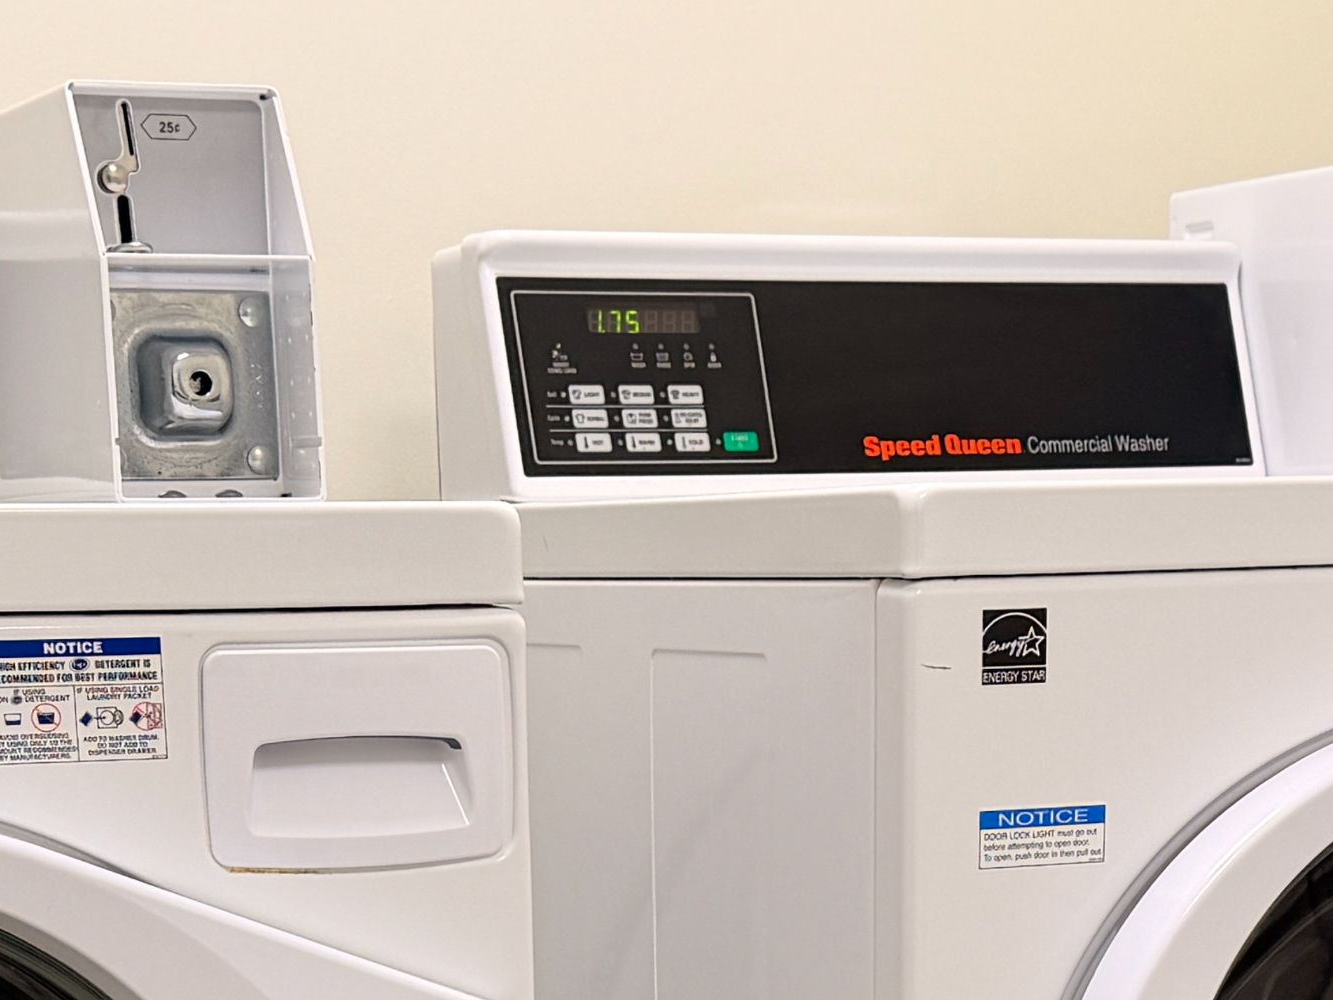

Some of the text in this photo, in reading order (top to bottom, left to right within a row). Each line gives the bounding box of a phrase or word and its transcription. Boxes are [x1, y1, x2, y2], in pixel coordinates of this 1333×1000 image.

[863, 433, 1169, 461] Speed Queen Commercial Washer
[43, 641, 103, 655] NOTICE
[18, 661, 65, 671] EFFICIENCY
[95, 659, 140, 669] DETERGENT
[143, 659, 151, 668] IS
[56, 673, 73, 682] FOR
[75, 672, 95, 682] BEST
[98, 671, 157, 681] PERFORMANCE
[983, 670, 1046, 683] ENERGY STAR
[22, 688, 45, 696] USING
[139, 685, 159, 693] LOAD
[25, 694, 70, 703] DETERGENT
[998, 808, 1089, 827] NOTICE
[983, 832, 1008, 841] DOOR
[1009, 831, 1030, 840] LOCK
[1032, 830, 1055, 839] LIGHT
[1057, 829, 1074, 837] must
[1075, 829, 1085, 837] go
[983, 843, 1005, 851] before
[1007, 841, 1044, 851] attempting
[1045, 840, 1052, 848] to
[1054, 841, 1071, 849] open
[984, 853, 993, 862] To
[1015, 853, 1032, 861] push
[1033, 851, 1049, 859] door
[1051, 850, 1058, 858] in
[1060, 850, 1075, 858] then
[1076, 848, 1088, 858] pull
